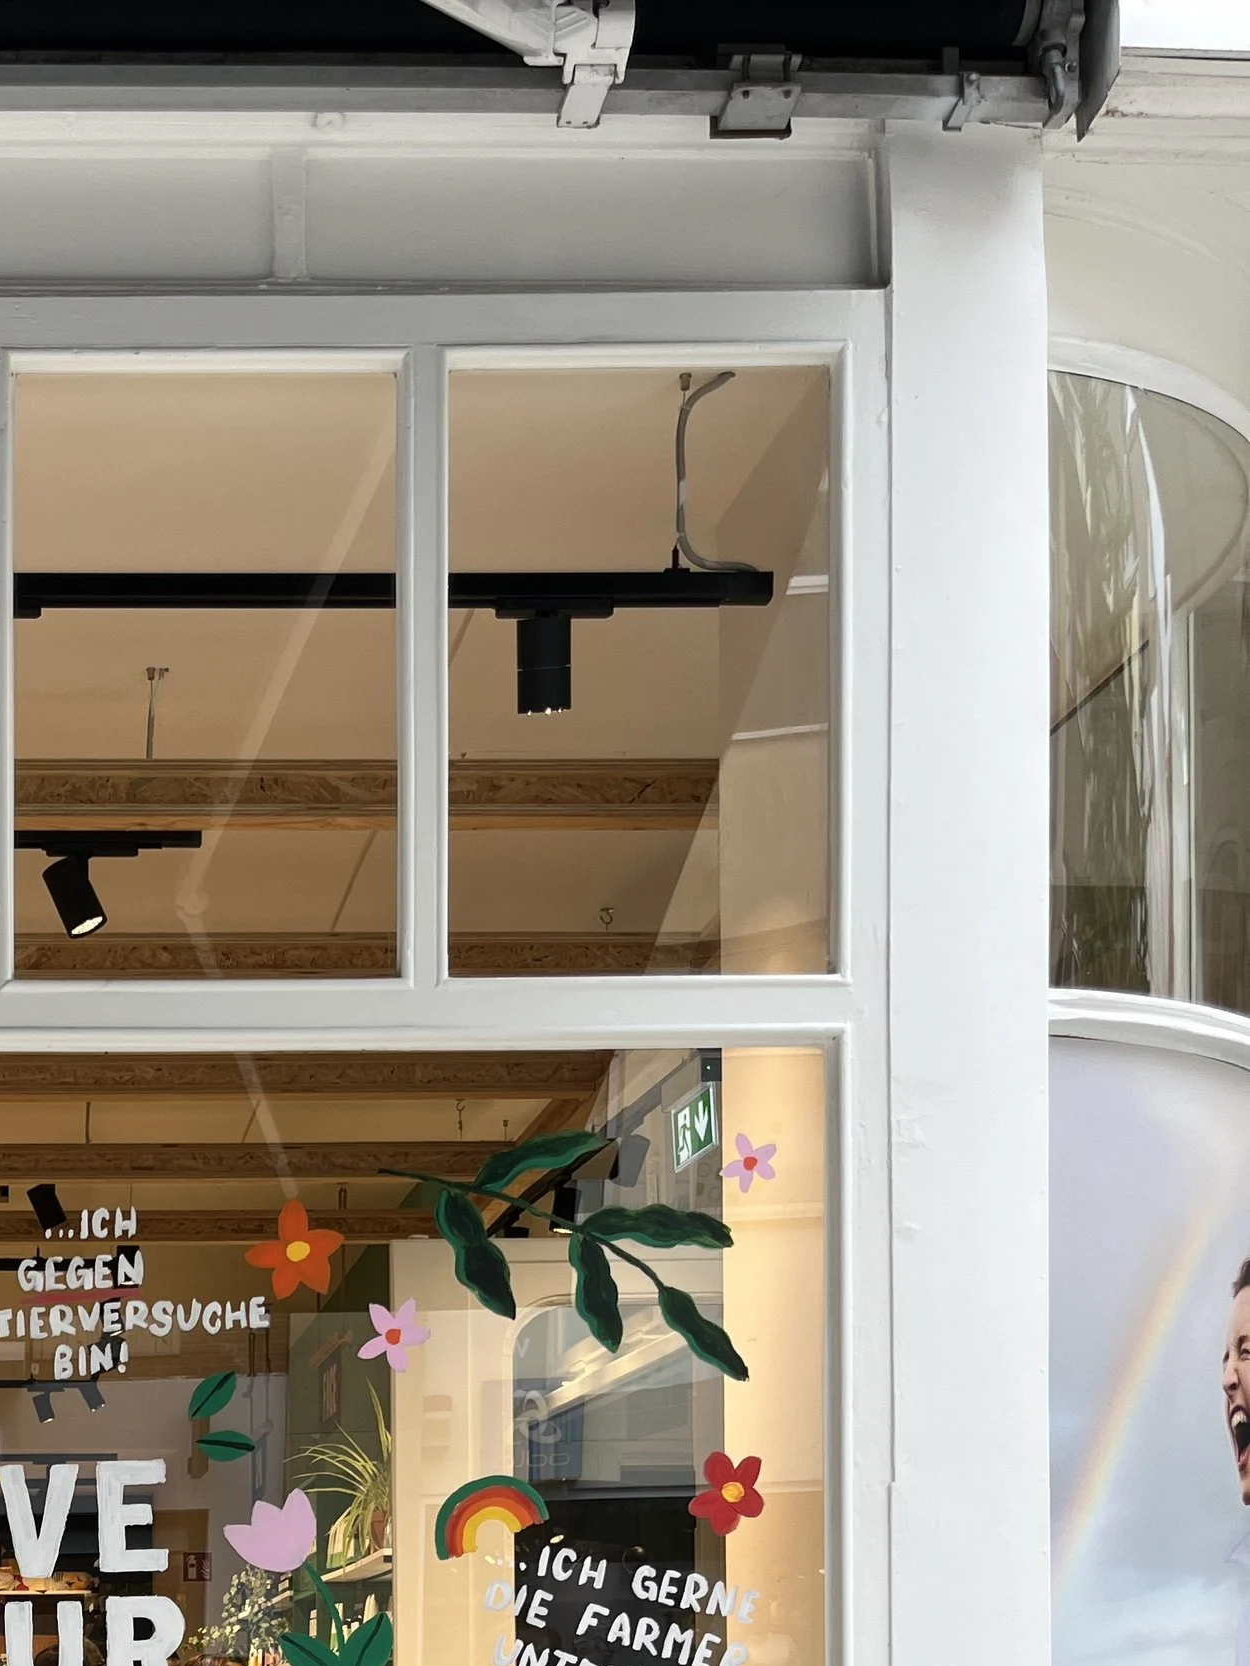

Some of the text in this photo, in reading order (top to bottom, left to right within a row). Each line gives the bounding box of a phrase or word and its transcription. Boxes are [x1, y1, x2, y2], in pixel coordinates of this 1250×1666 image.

[17, 1250, 144, 1291] GEGEN
[53, 1341, 129, 1380] BIN!
[484, 1579, 553, 1628] DIE
[632, 1564, 760, 1625] GERNE
